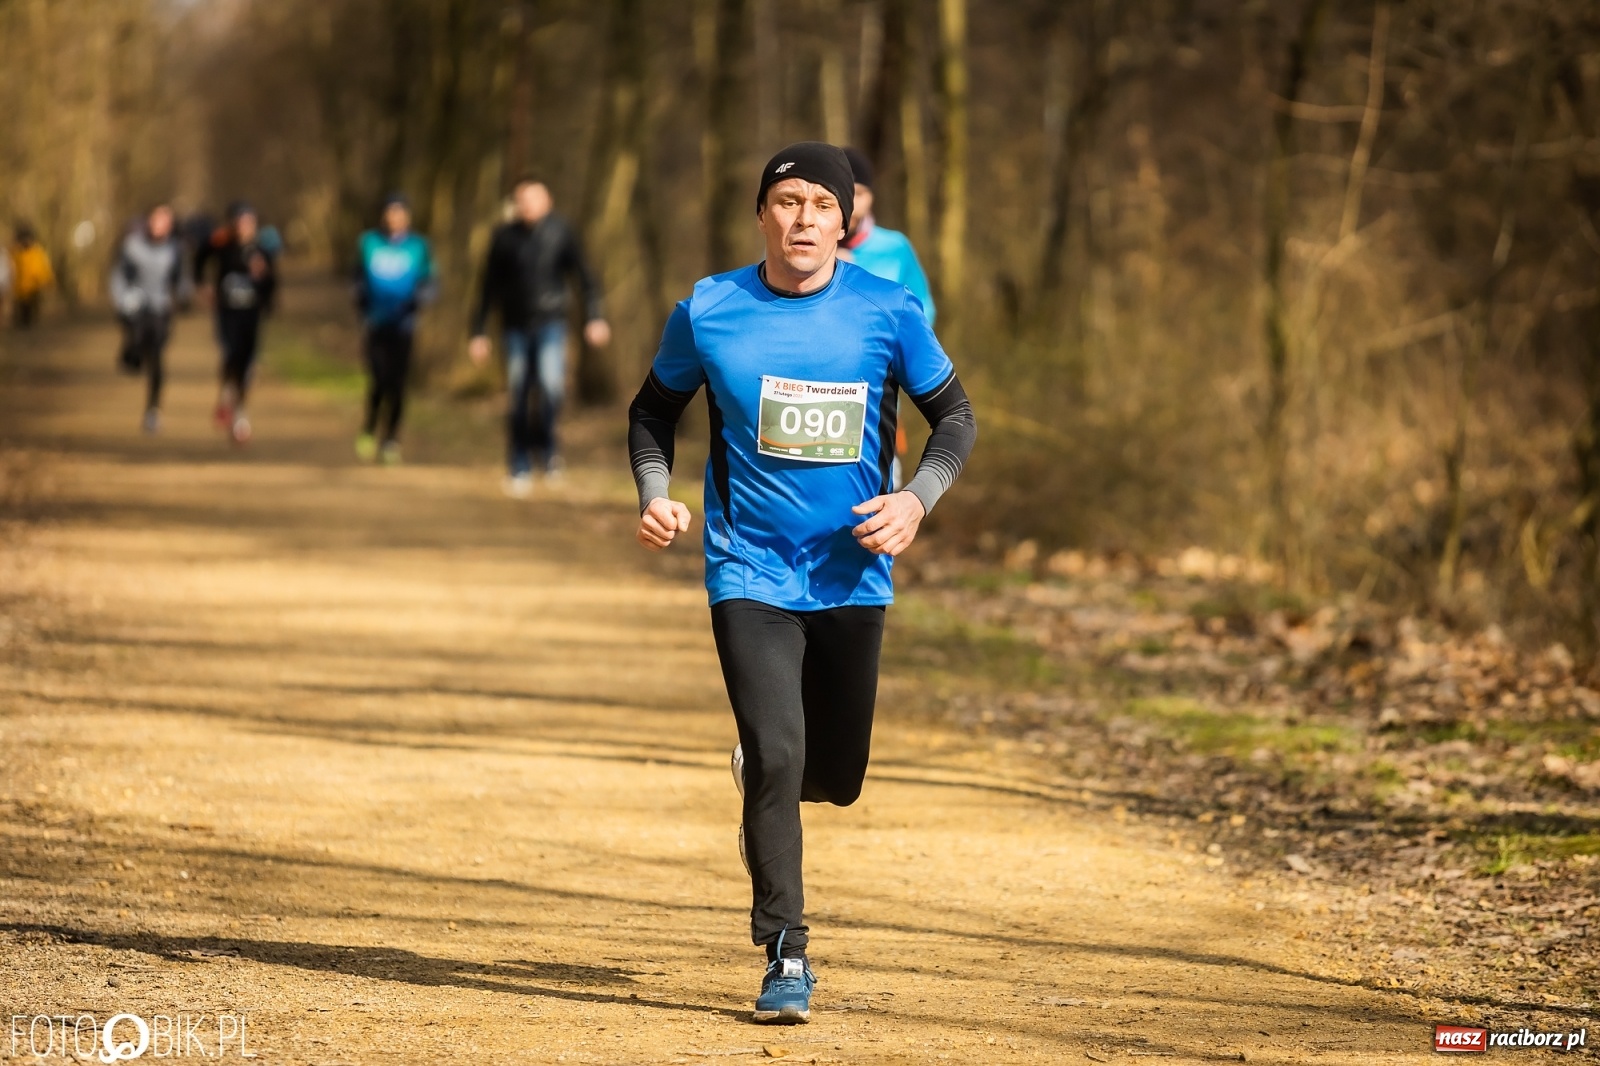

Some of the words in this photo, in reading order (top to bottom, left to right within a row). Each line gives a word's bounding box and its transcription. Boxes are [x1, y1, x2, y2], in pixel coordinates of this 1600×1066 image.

[774, 381, 781, 390] X
[782, 382, 804, 392] BIEG
[806, 385, 857, 395] Twardziela
[780, 406, 847, 438] 090
